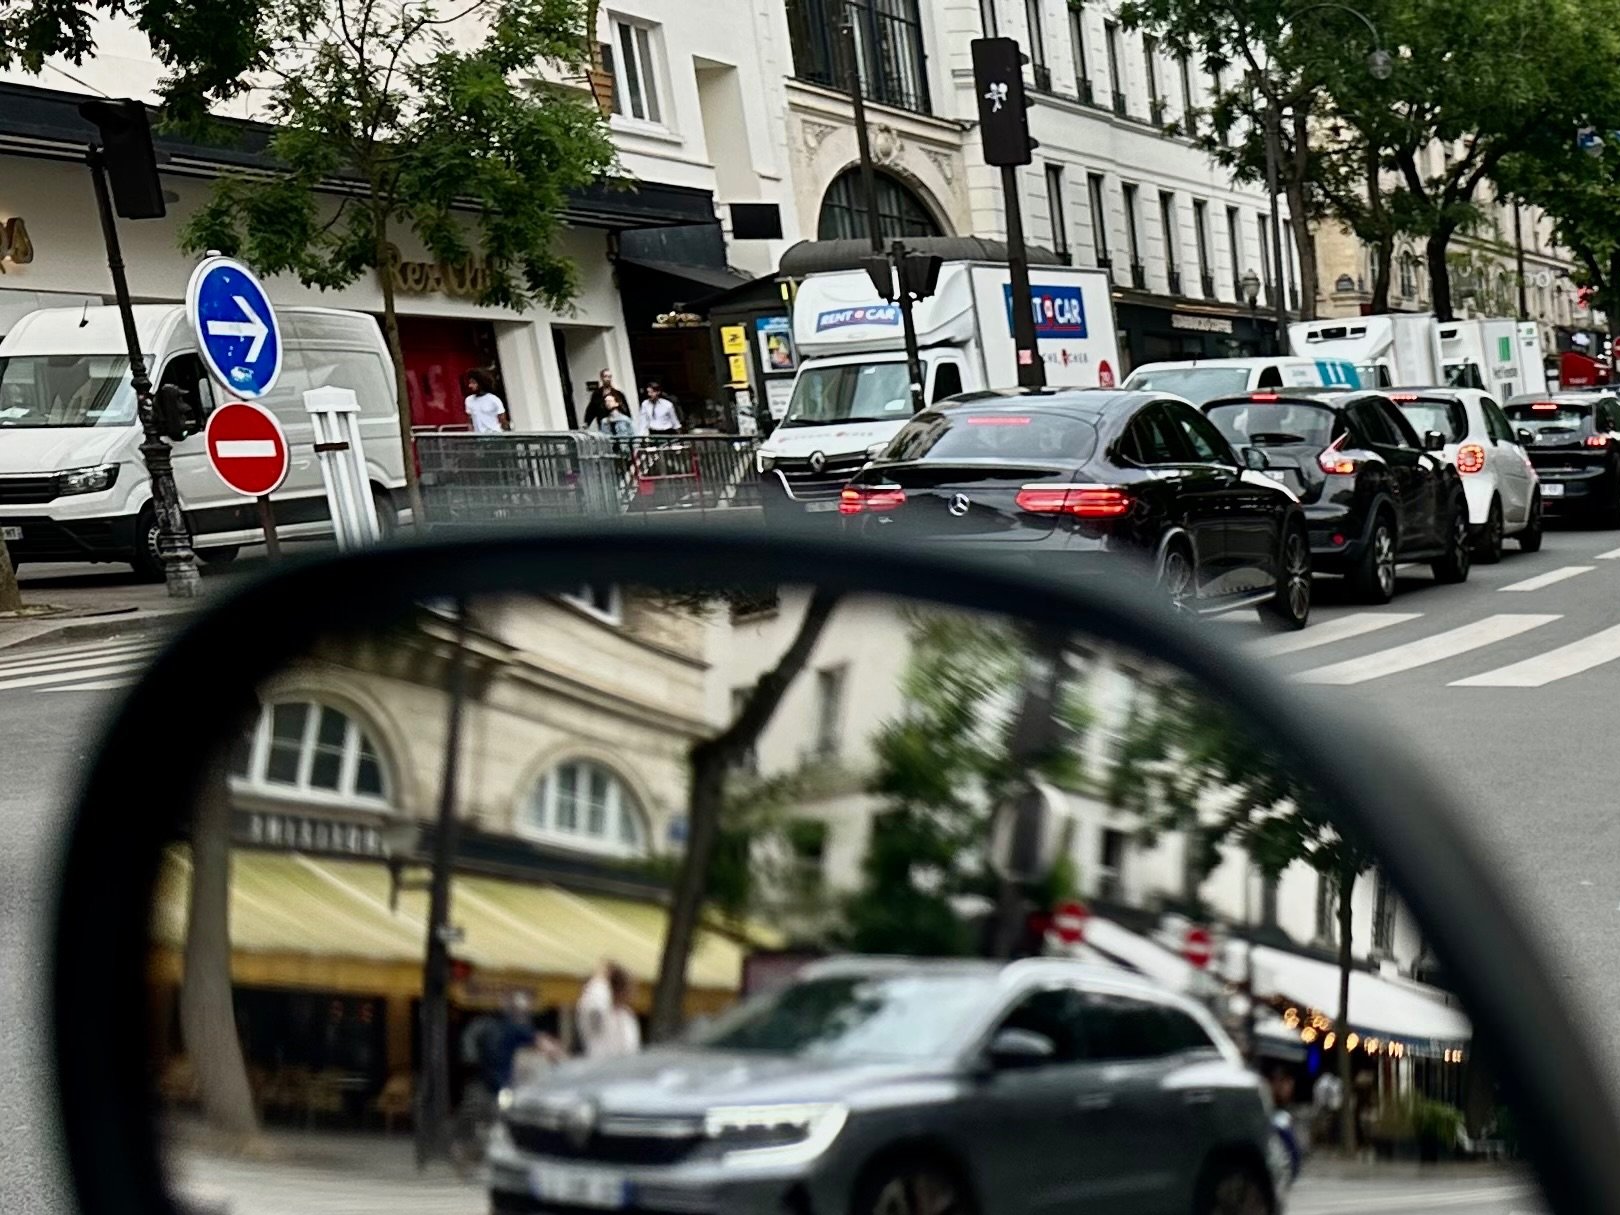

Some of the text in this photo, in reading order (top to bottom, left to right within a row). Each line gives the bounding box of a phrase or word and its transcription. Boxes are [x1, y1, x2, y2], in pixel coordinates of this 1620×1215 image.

[820, 311, 853, 326] RENT
[865, 307, 896, 321] CAR
[1054, 298, 1082, 324] CAR
